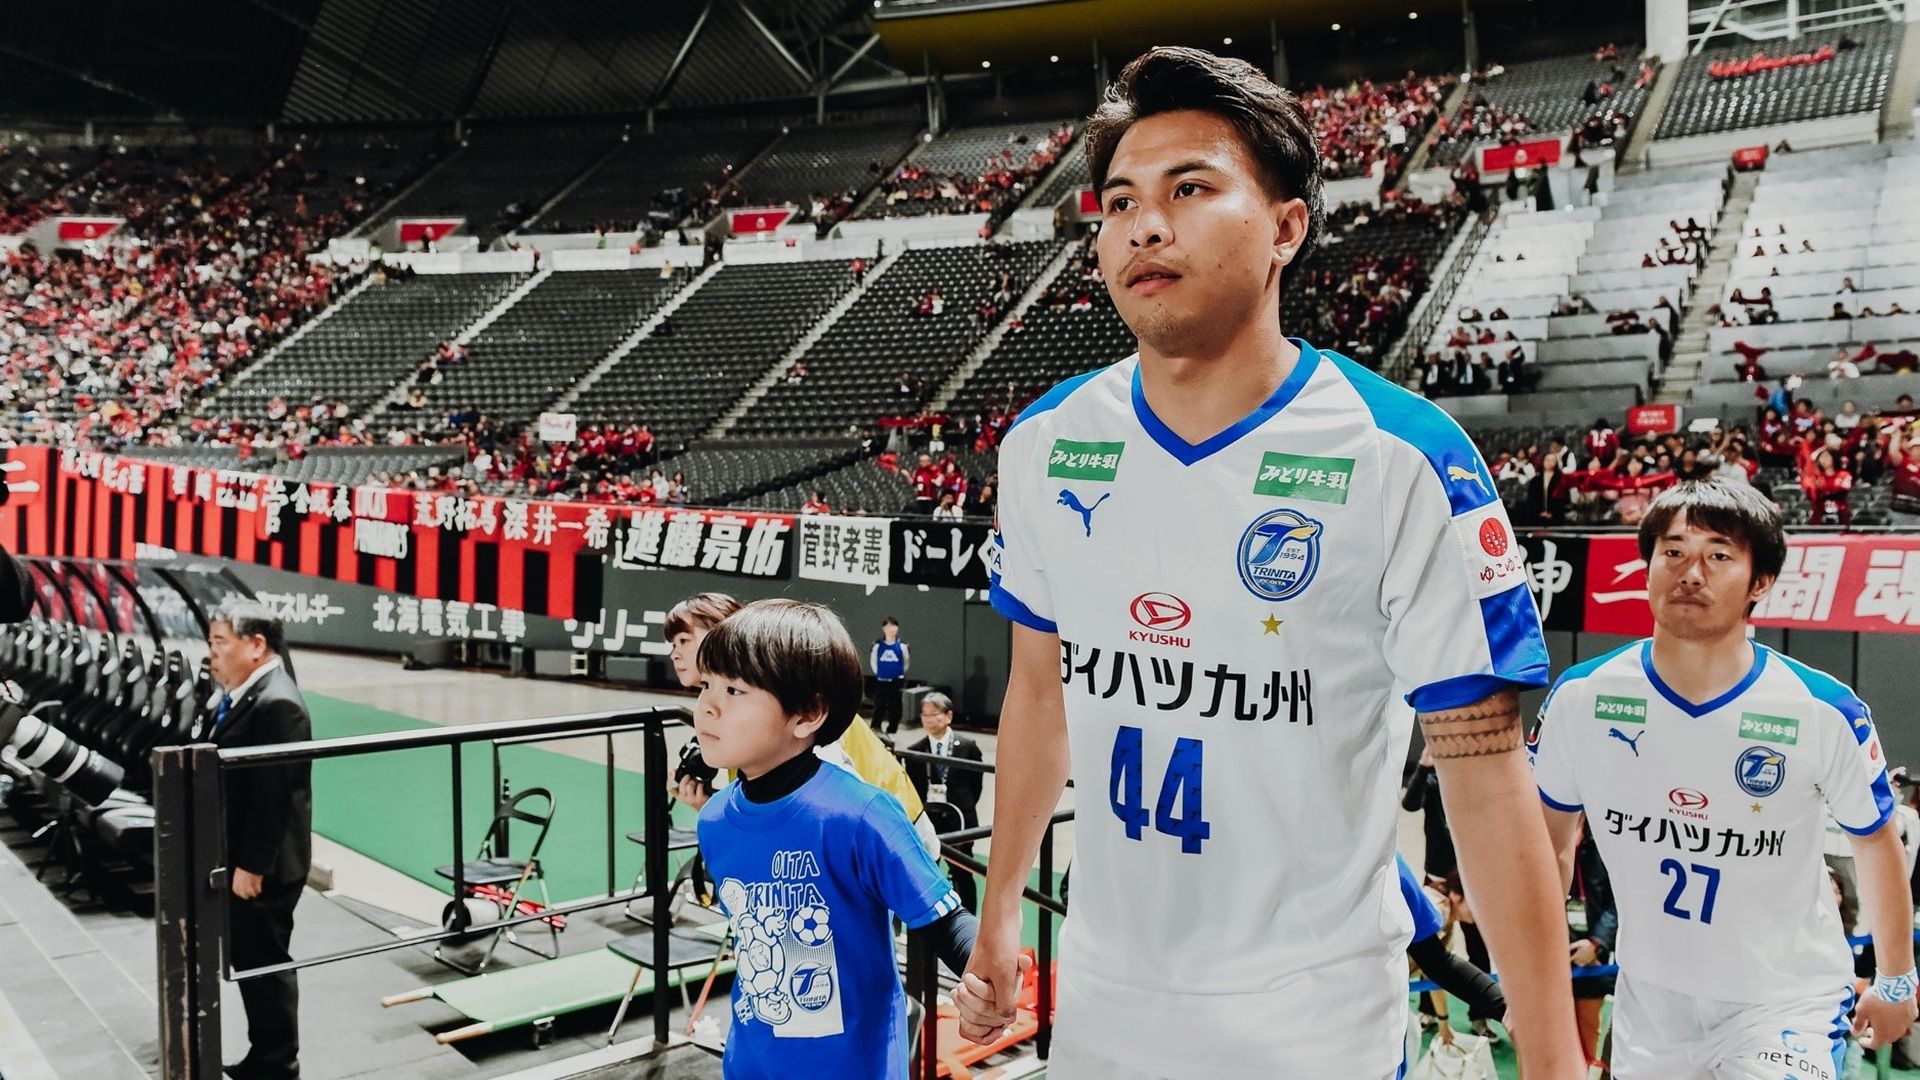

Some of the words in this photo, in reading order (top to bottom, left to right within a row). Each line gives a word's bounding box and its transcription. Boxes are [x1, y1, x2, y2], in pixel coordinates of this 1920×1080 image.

[1253, 566, 1296, 580] TRINITA
[372, 594, 526, 643] 北海電気工事
[1128, 630, 1191, 649] KYUSHU
[1109, 725, 1211, 855] 44
[1668, 808, 1709, 821] KYUSHU
[1605, 808, 1786, 858] ダイハツ九州
[772, 850, 821, 880] OITA
[744, 881, 826, 912] TRINITA
[1660, 858, 1721, 925] 27
[1757, 1050, 1794, 1067] net
